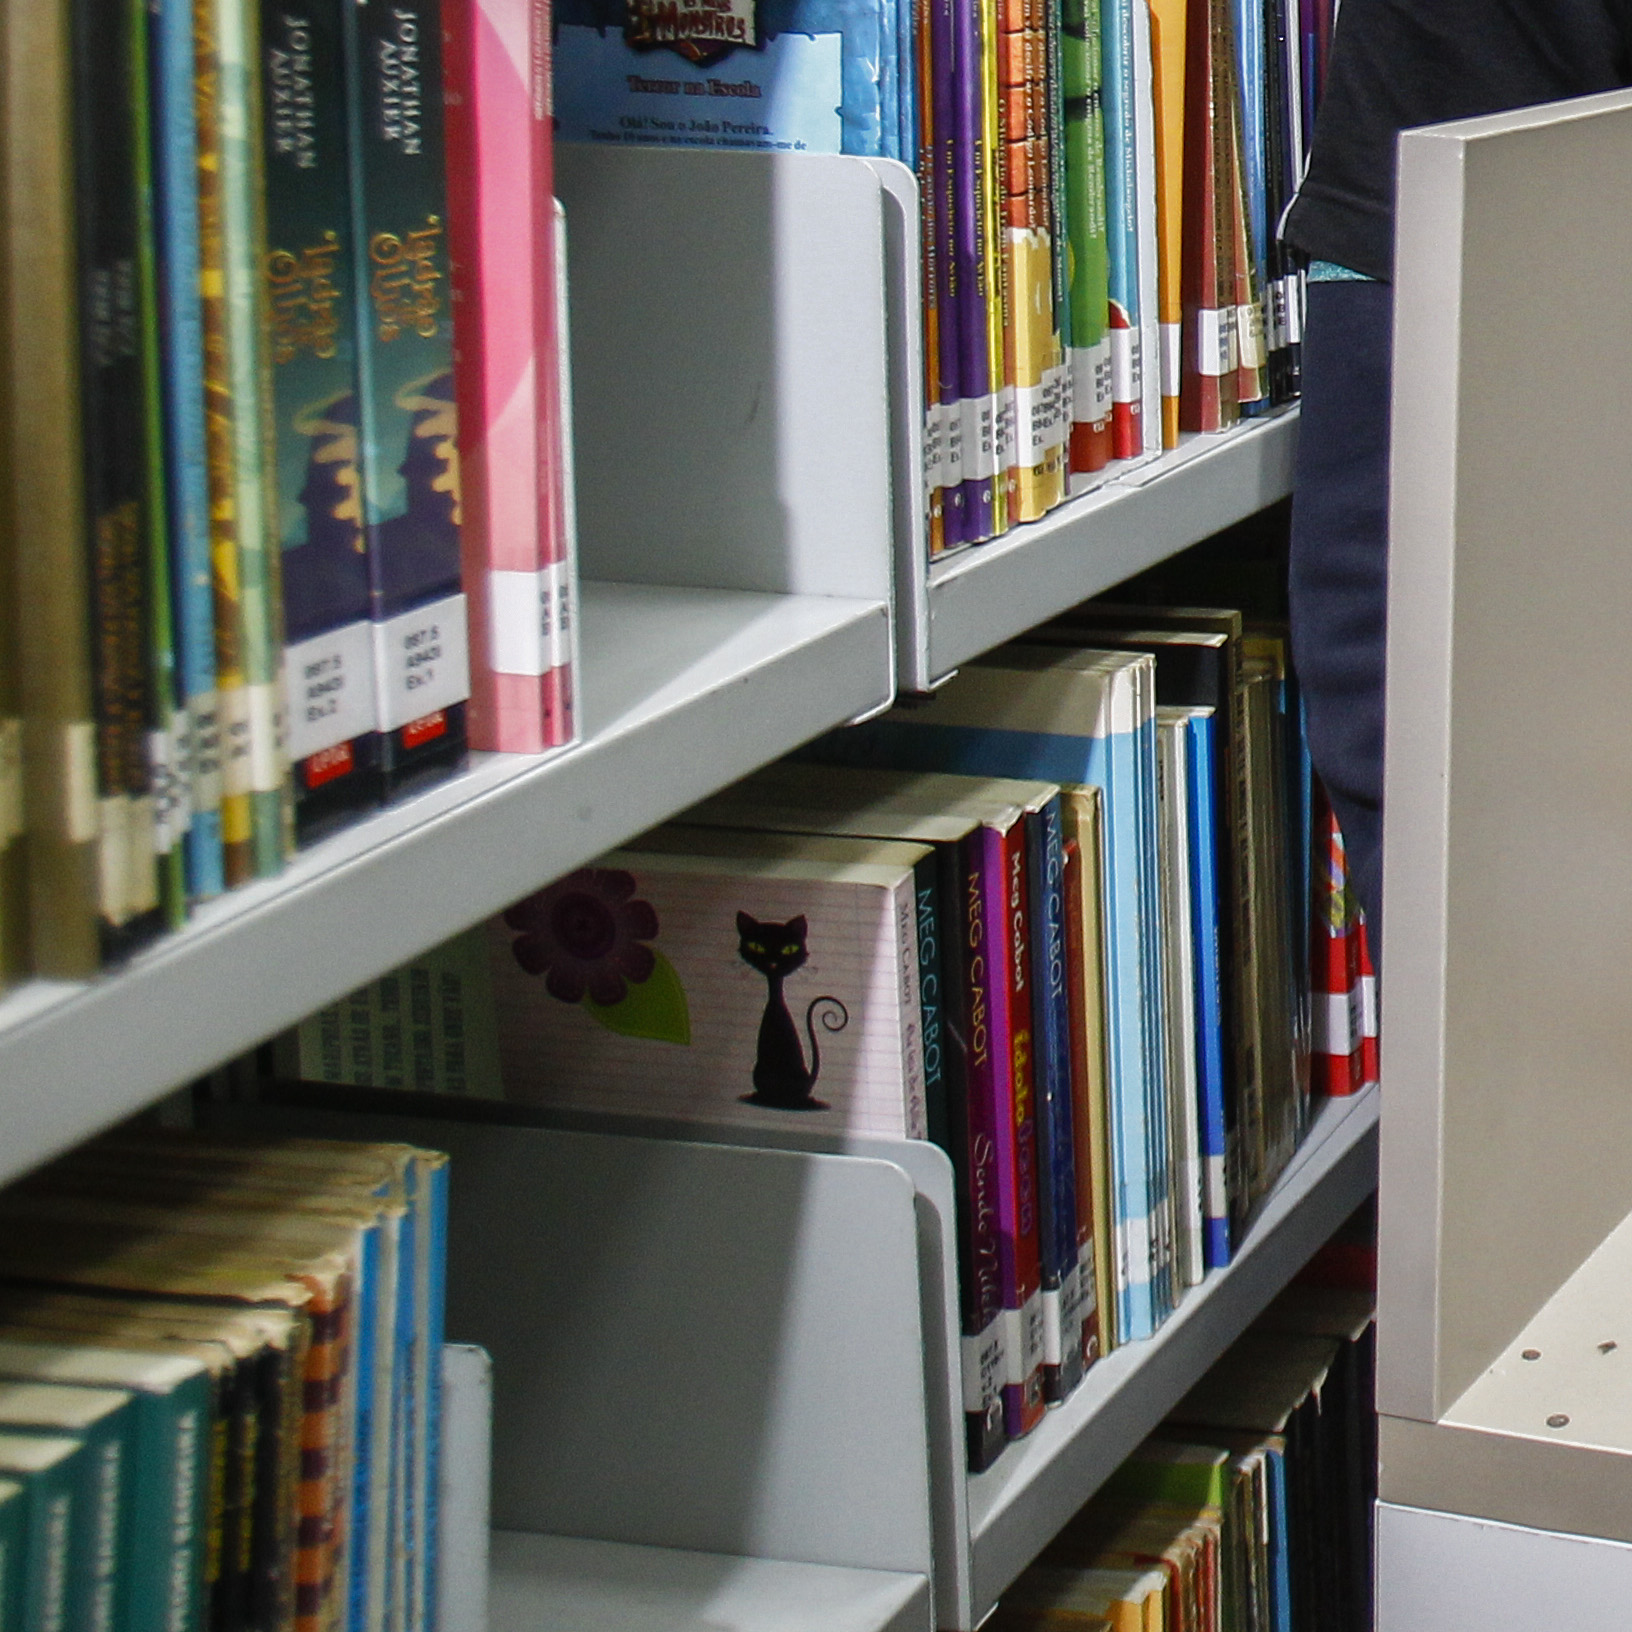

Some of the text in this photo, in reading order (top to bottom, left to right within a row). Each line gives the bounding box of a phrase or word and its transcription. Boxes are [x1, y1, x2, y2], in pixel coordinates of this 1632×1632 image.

[269, 46, 296, 155] AUXIER
[283, 14, 318, 169] JONATHAN
[378, 39, 402, 142] AUXIER
[391, 8, 422, 155] JONATHAN
[706, 78, 762, 99] Escola
[794, 138, 808, 151] de
[967, 872, 988, 1068] MEG CABOT
[1011, 851, 1025, 992] Meg Cabot
[1046, 809, 1062, 999] MEG CABOT
[918, 887, 941, 1086] MEG CABOT
